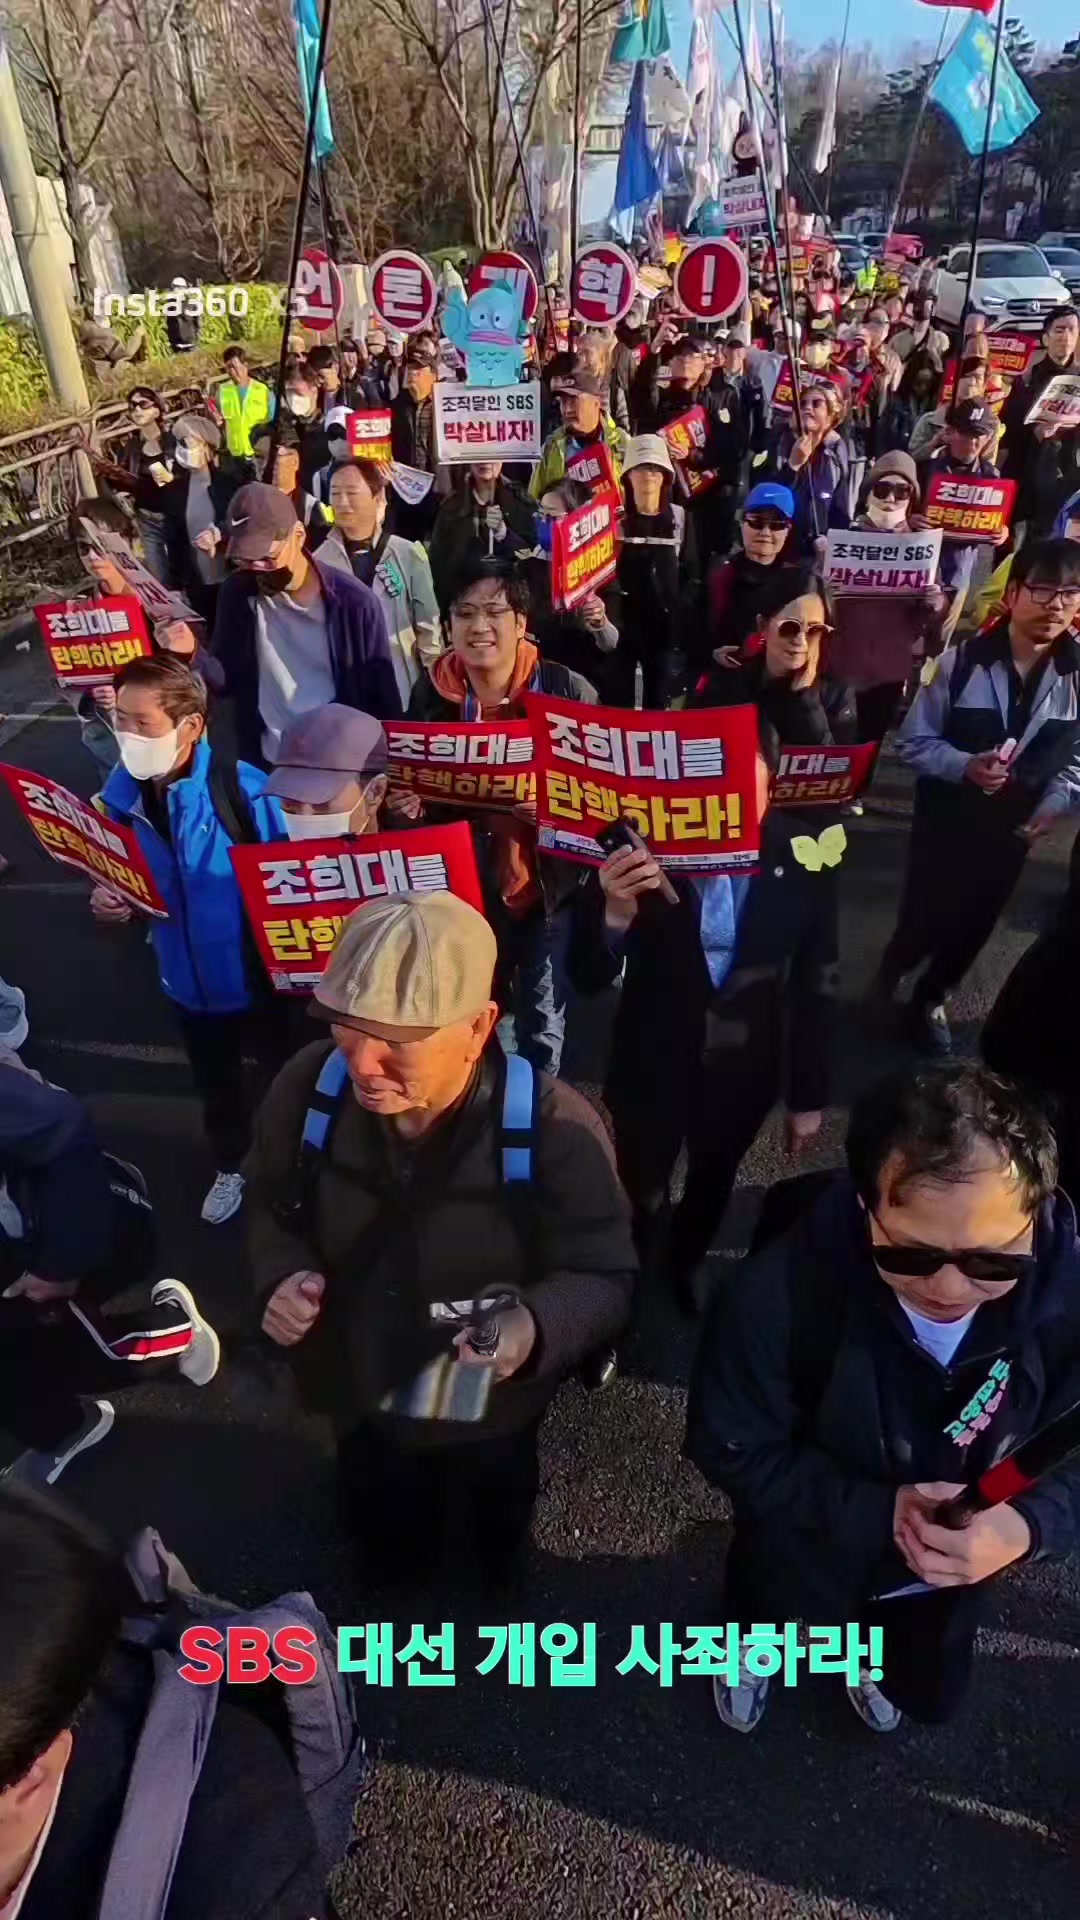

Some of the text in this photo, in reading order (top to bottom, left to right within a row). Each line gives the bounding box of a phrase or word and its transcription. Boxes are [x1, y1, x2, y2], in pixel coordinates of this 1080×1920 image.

[382, 266, 423, 320] 론
[578, 257, 623, 315] 혁
[506, 394, 534, 411] SBS
[444, 420, 534, 443] 박살내자!
[903, 543, 935, 562] SBS
[45, 608, 130, 639] 조희대를
[50, 639, 144, 671] 탄핵하라!
[388, 731, 504, 765] 조희대를
[545, 711, 724, 781] 조희대를
[386, 764, 537, 803] 탄핵하라!
[545, 768, 743, 841] 탄핵하라!
[17, 779, 129, 861] 조희대를
[27, 813, 153, 903] 탄핵하라!
[258, 848, 449, 905] 조희대를
